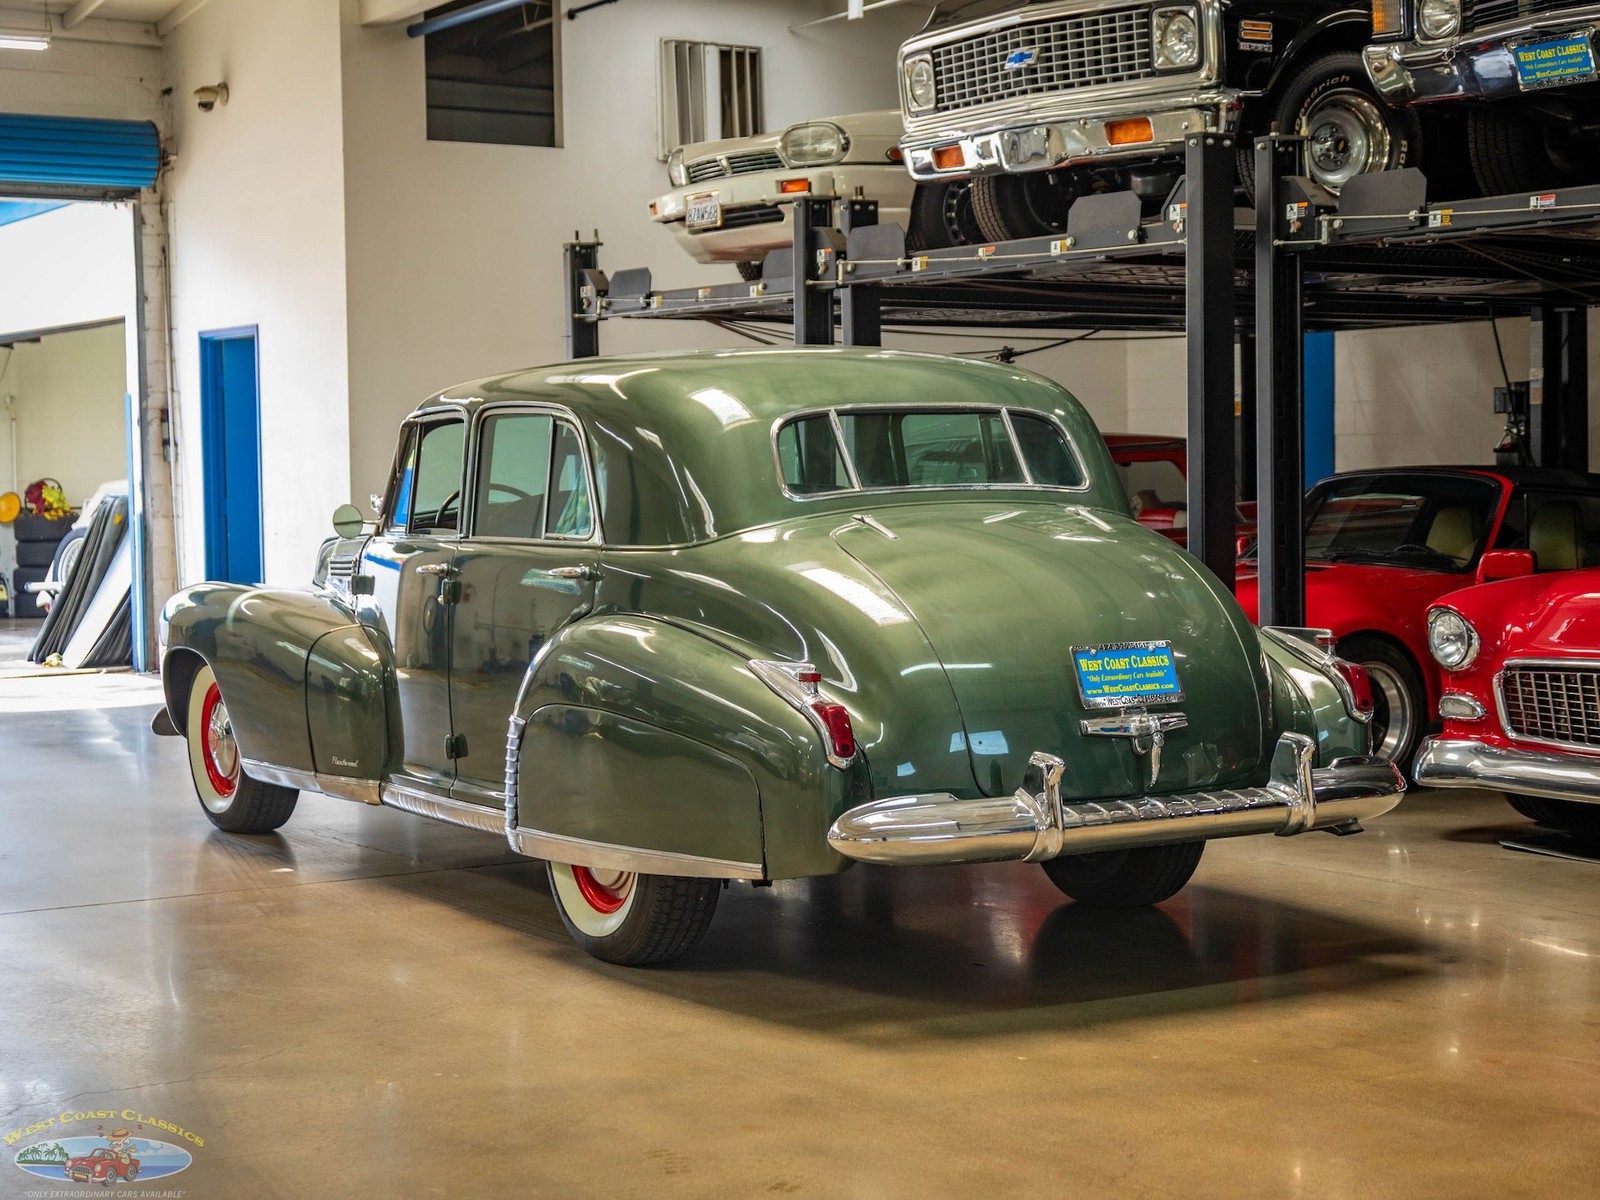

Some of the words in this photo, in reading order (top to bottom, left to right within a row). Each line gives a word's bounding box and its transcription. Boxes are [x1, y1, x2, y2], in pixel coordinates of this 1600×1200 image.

[1518, 51, 1535, 62] WEST
[1536, 48, 1555, 59] COAST
[1557, 43, 1587, 56] CLASSICS
[1079, 658, 1103, 672] WEST
[1104, 656, 1130, 670] COAST
[1131, 655, 1170, 668] CLASSICS
